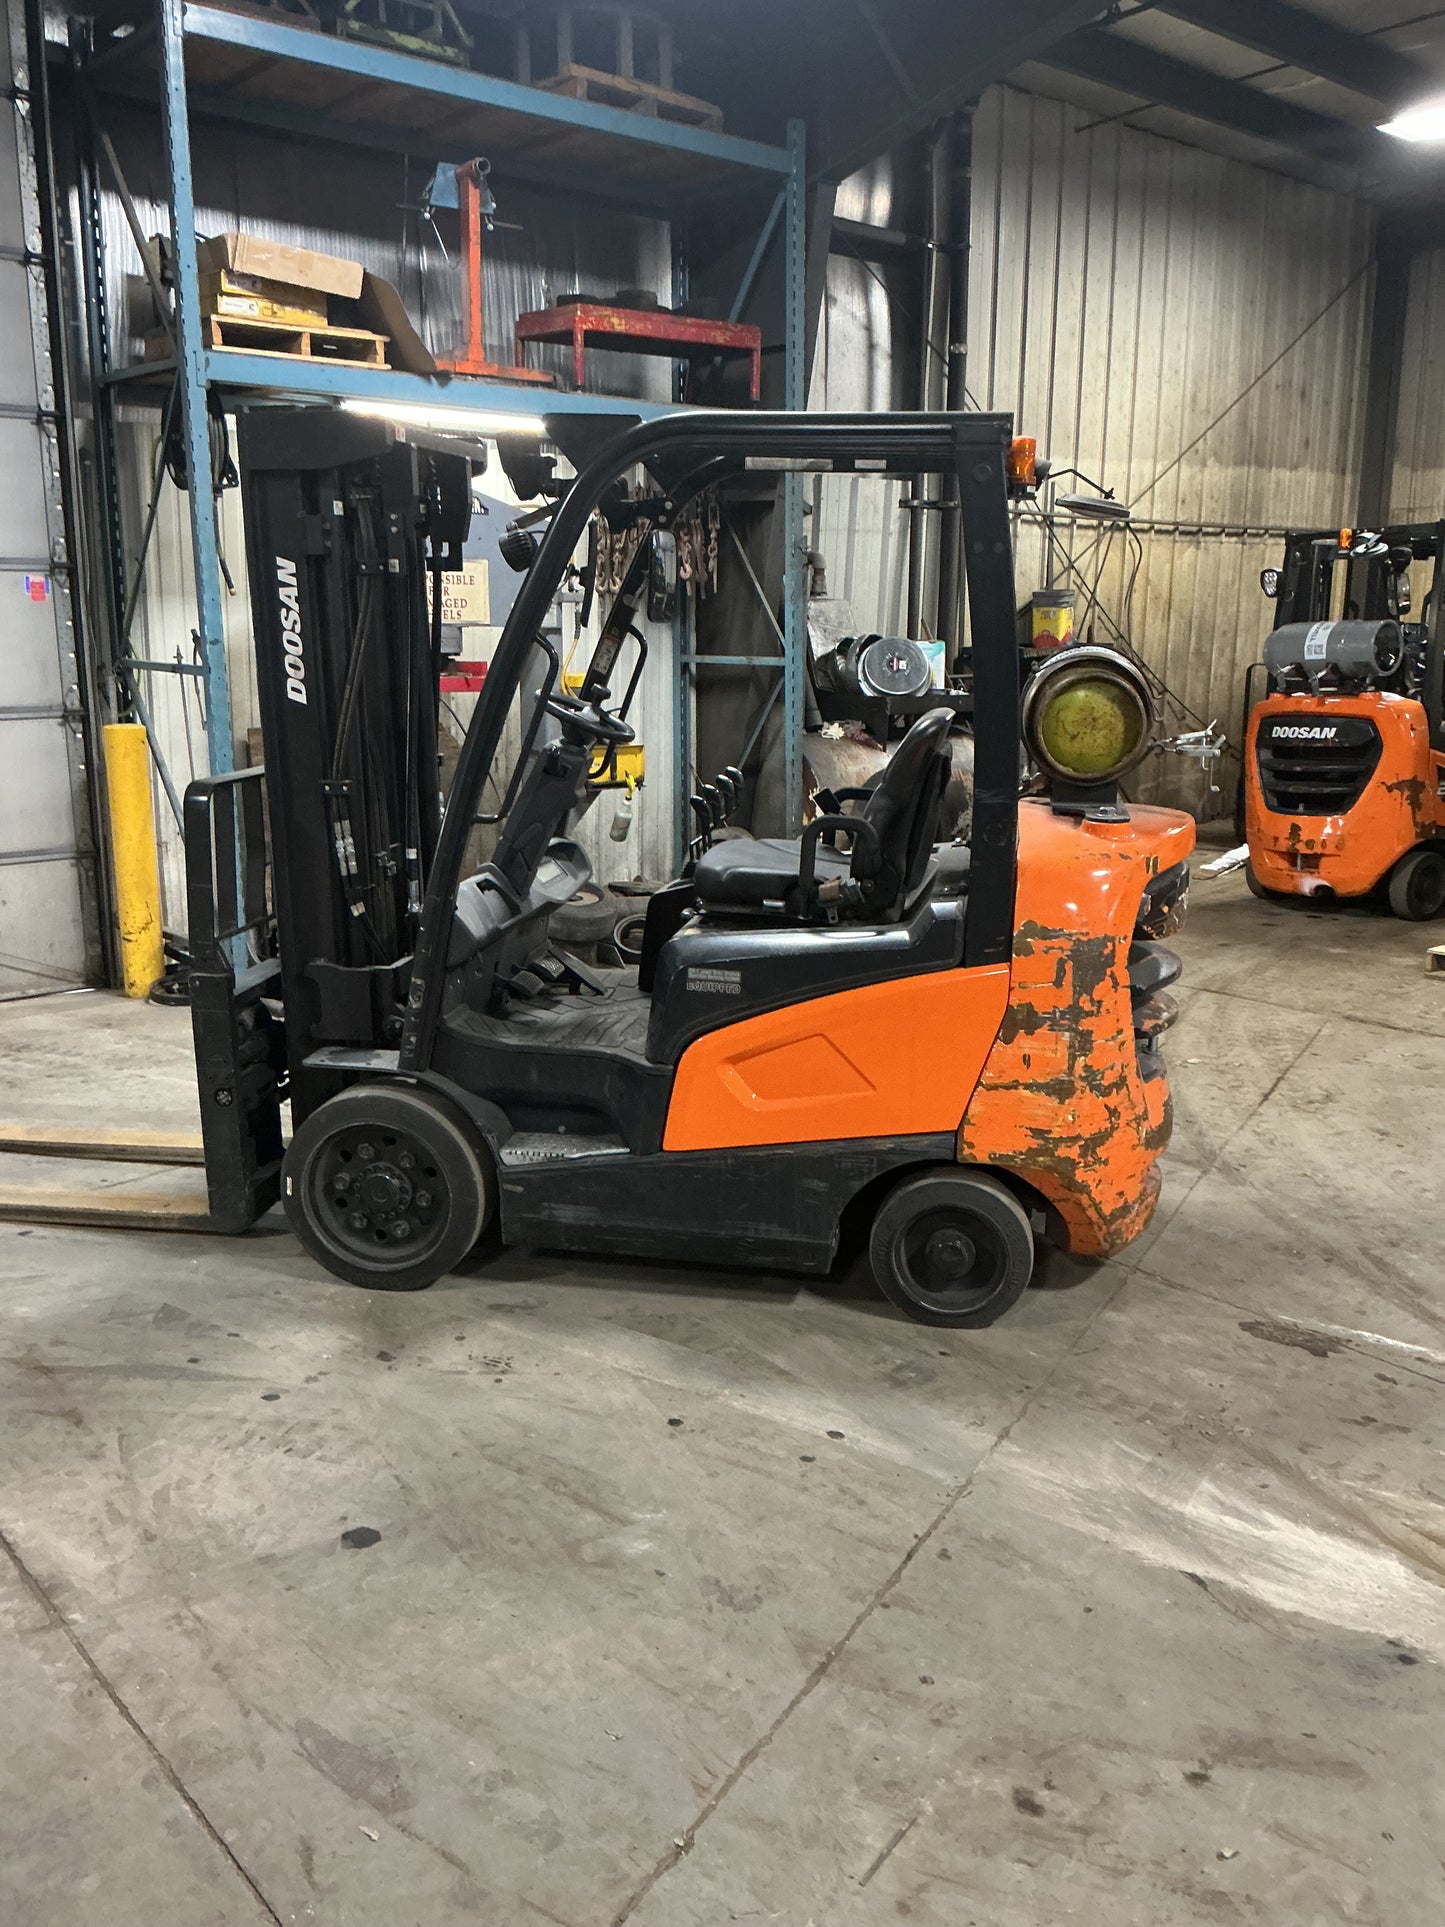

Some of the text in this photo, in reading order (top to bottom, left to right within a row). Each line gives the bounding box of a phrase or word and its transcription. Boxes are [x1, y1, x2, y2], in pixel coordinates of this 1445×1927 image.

[429, 586, 450, 596] FR
[275, 555, 307, 705] DOOSAN
[1271, 726, 1337, 739] DOOSAN
